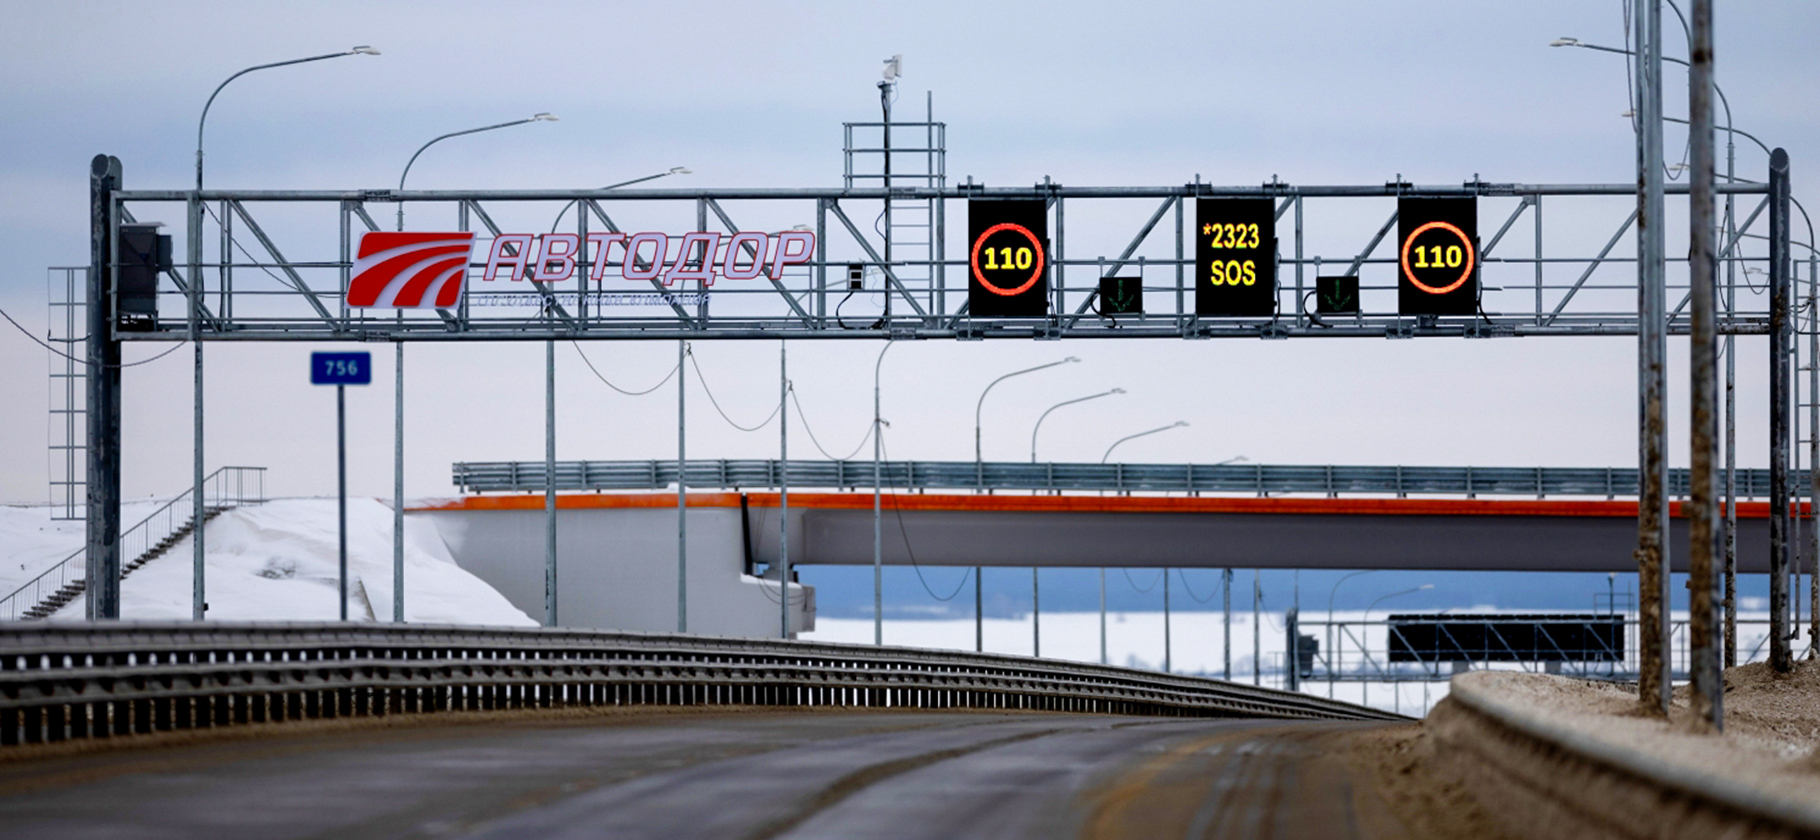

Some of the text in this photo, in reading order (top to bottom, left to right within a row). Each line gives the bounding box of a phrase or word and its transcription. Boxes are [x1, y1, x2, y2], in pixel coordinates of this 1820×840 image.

[482, 232, 815, 286] АВТОДОР
[984, 246, 1033, 270] 110
[1414, 245, 1463, 268] 110
[1211, 260, 1256, 287] SOS
[325, 360, 359, 376] 756
